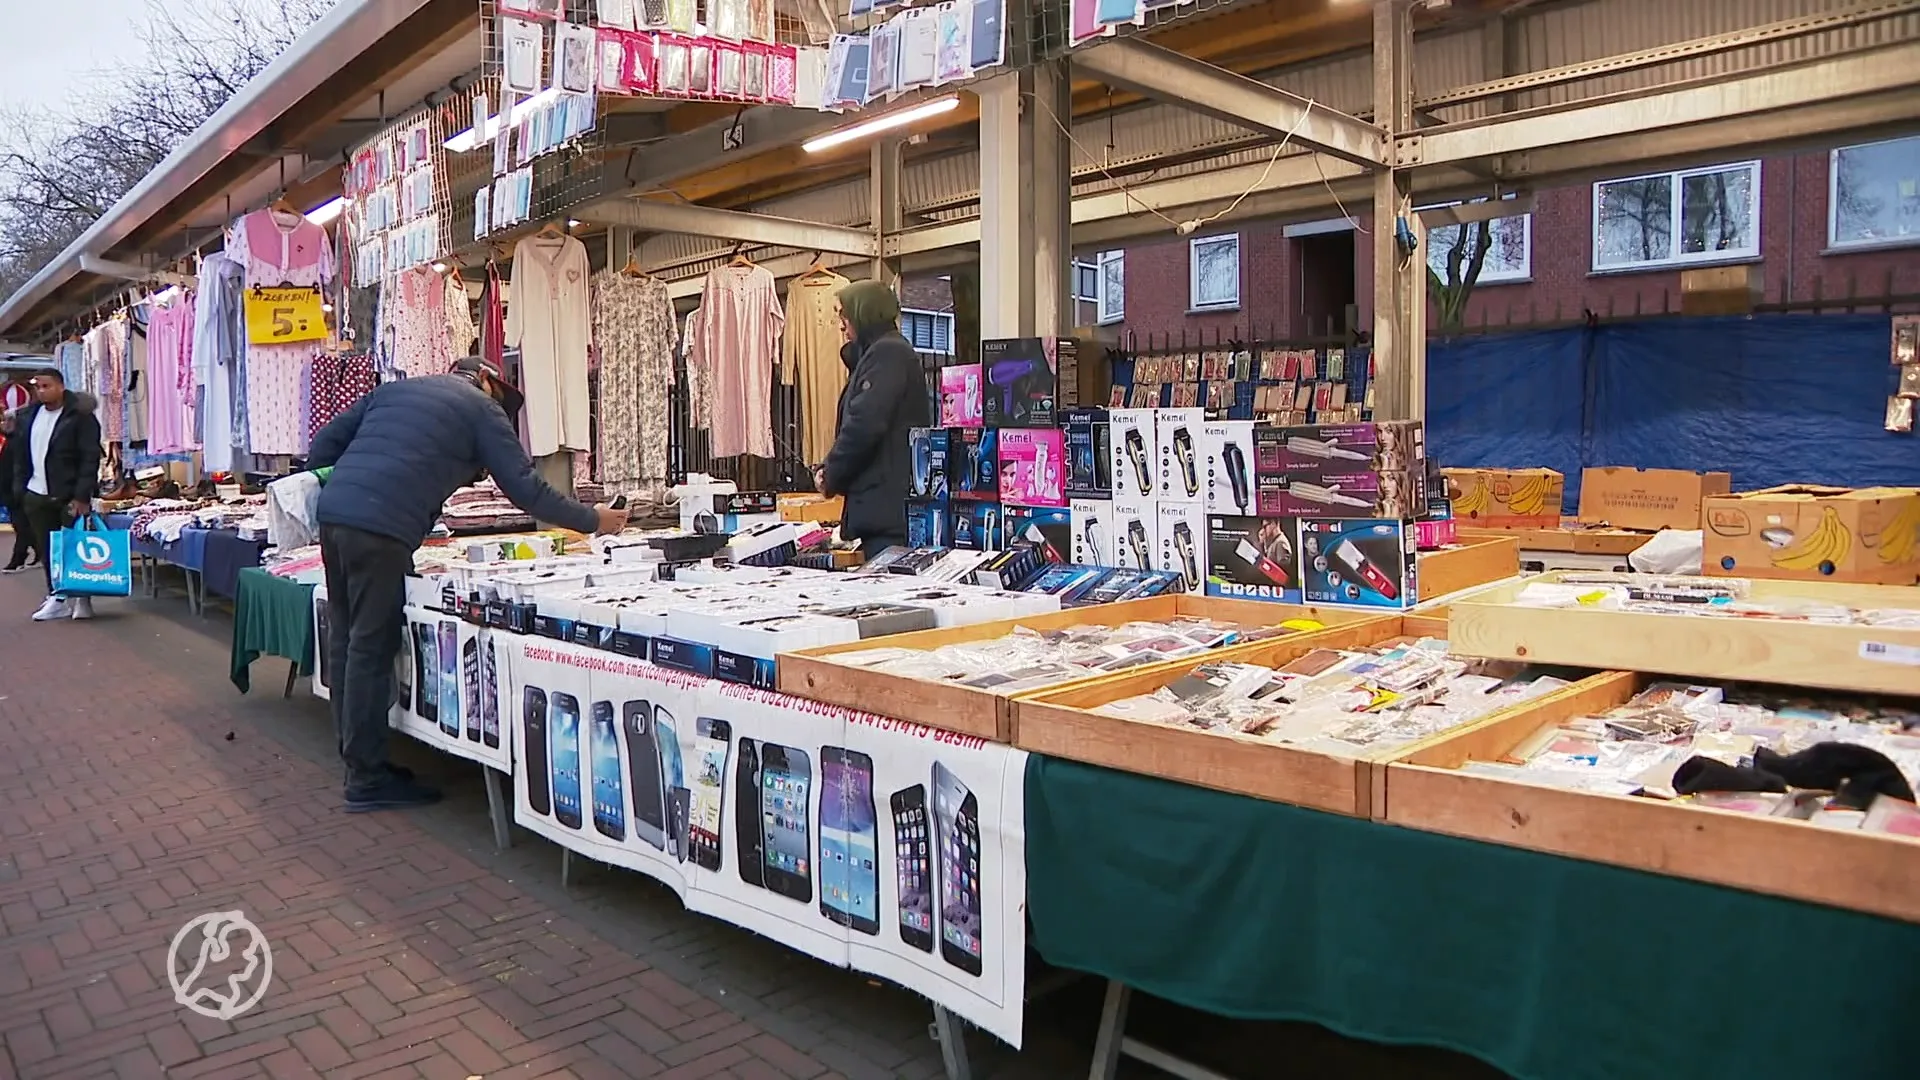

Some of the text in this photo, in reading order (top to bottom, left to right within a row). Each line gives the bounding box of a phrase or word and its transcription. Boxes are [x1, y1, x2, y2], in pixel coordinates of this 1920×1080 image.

[1069, 413, 1091, 421] Kemei
[1112, 414, 1138, 423] Kemei
[1161, 413, 1186, 422] Kemei
[1204, 427, 1228, 436] Kemei
[1257, 431, 1286, 441] Kemei
[1002, 432, 1032, 443] Kemei
[1259, 476, 1287, 485] Kemei
[1005, 507, 1032, 518] Kemei
[1073, 503, 1096, 513] Kemei
[1116, 505, 1140, 514] Kemei
[1161, 507, 1187, 517] Kemei
[1302, 521, 1342, 533] Kemei
[523, 642, 554, 663] facebook:
[656, 641, 674, 654] Kemei
[718, 654, 736, 666] Kemei
